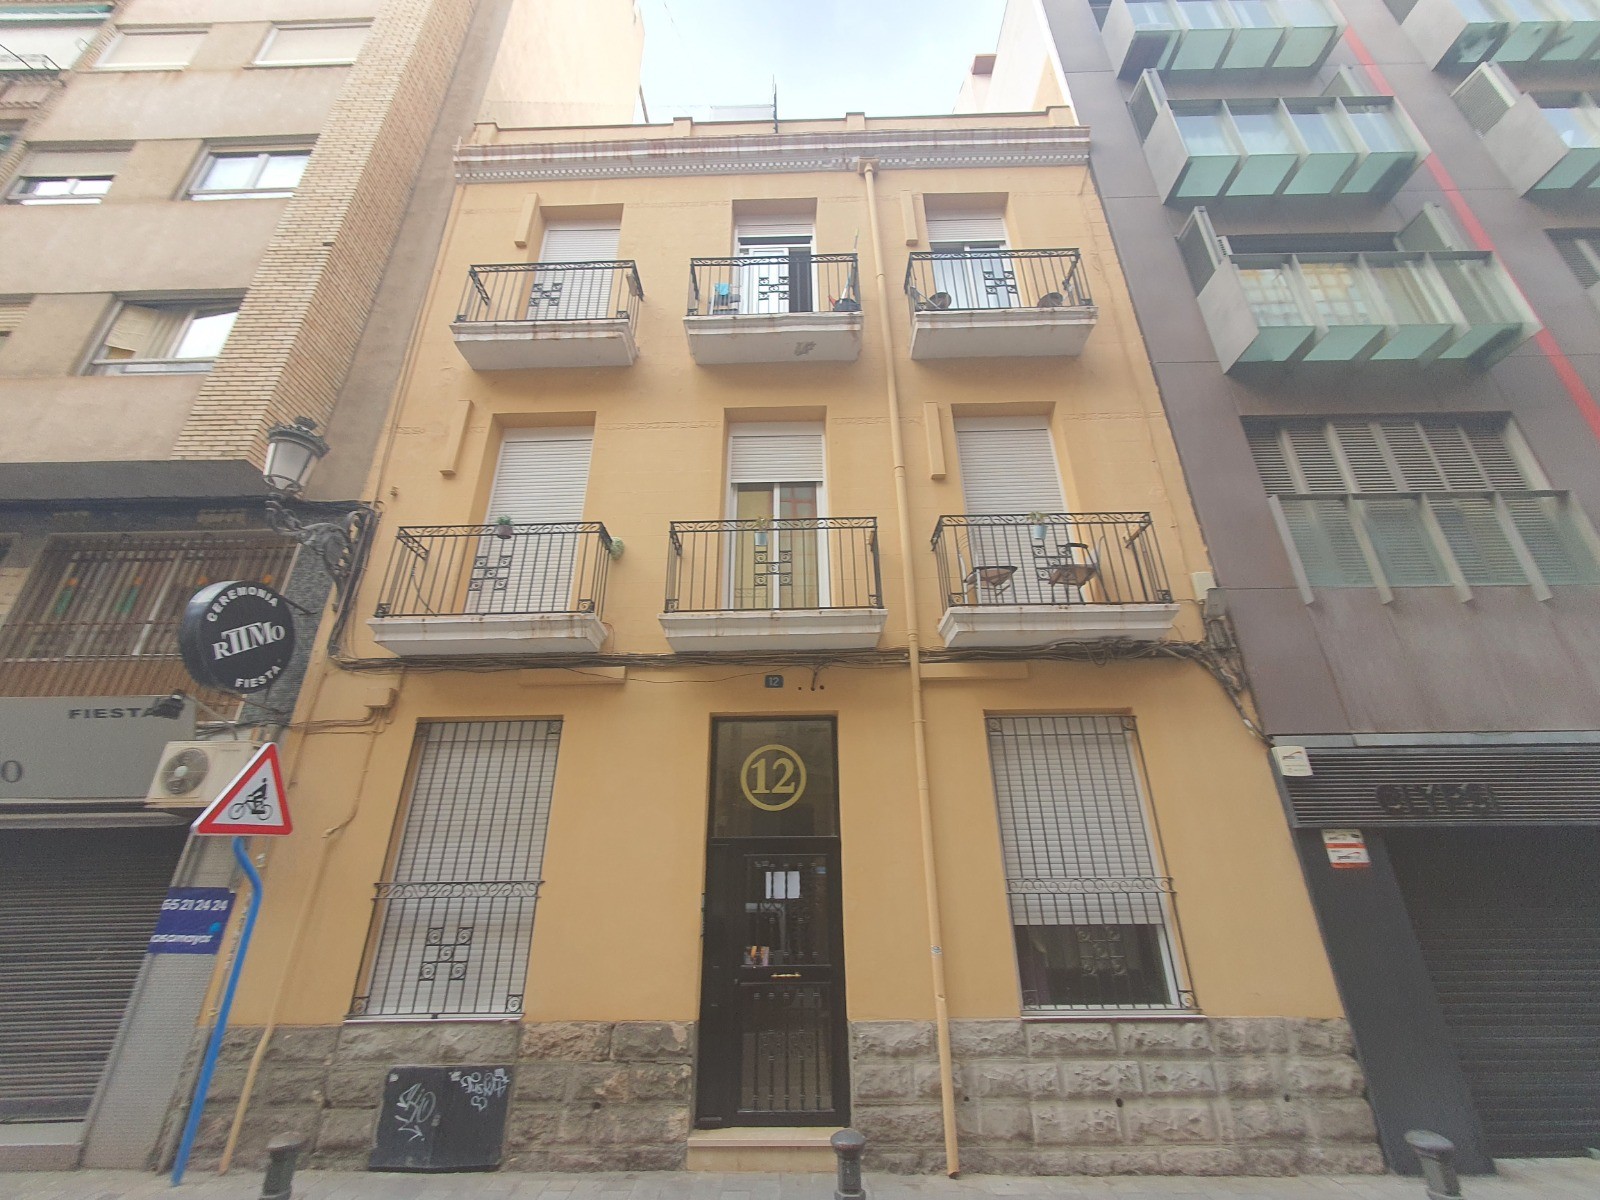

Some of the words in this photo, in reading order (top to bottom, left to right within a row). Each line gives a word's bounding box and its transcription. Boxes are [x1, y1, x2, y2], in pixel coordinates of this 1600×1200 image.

[206, 586, 279, 622] CEREMONIA
[235, 665, 281, 688] FIESTA
[768, 676, 780, 687] 12
[750, 757, 796, 794] 12
[194, 899, 212, 910] 24
[210, 899, 228, 910] 24
